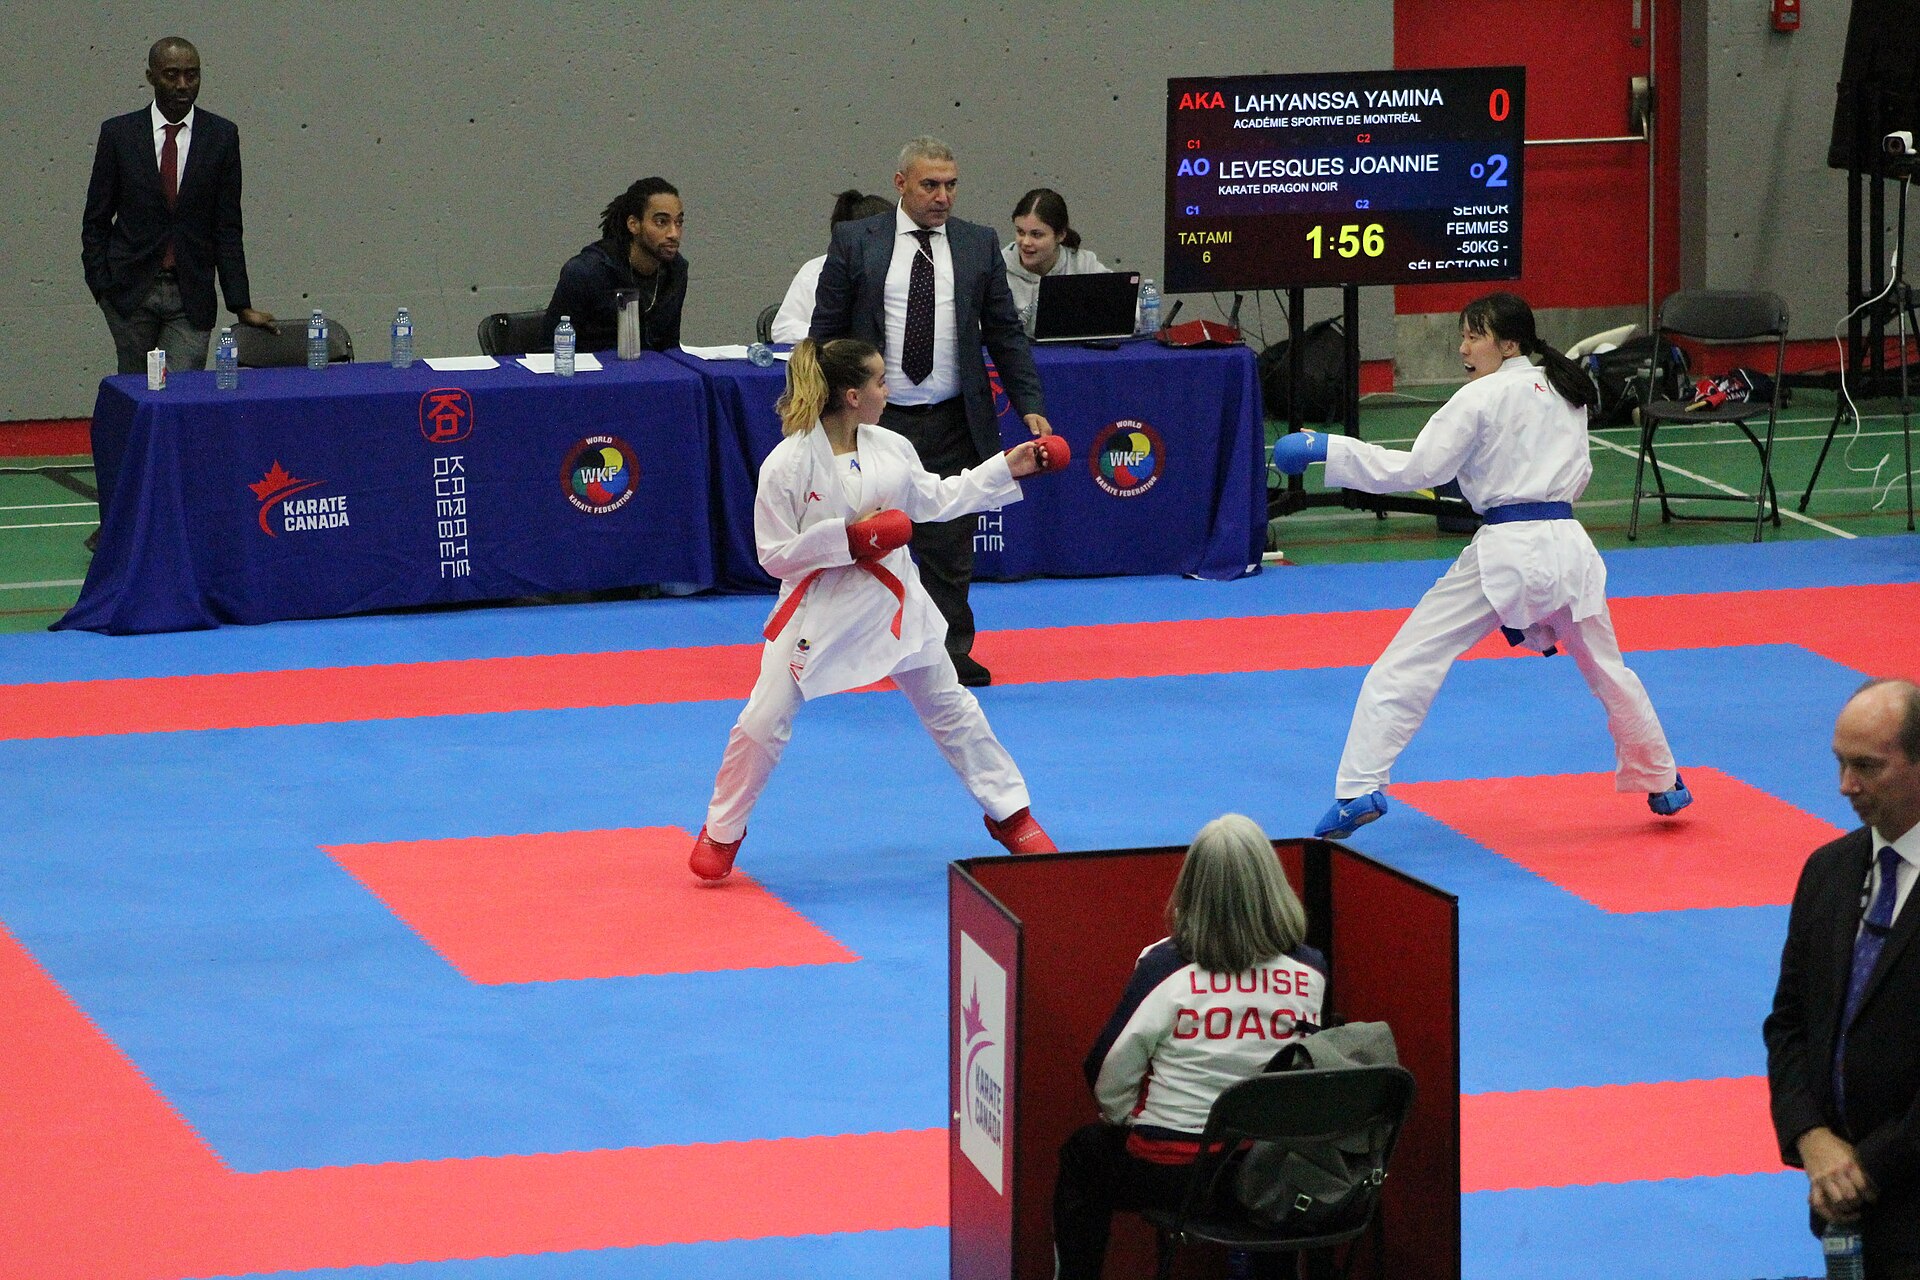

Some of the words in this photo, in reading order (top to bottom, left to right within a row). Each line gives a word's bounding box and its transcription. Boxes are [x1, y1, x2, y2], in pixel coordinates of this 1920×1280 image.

[1179, 91, 1225, 110] AKA
[1234, 91, 1359, 113] LAHYANSSA
[1363, 88, 1444, 108] YAMINA
[1489, 88, 1510, 121] 0
[1233, 116, 1289, 129] ACADÉMIE
[1291, 115, 1344, 127] SPORTIVE
[1346, 115, 1362, 125] DE
[1363, 111, 1422, 125] MONTRÉAL
[1187, 139, 1200, 149] C1
[1356, 133, 1371, 143] C2
[1177, 157, 1211, 177] AO
[1219, 157, 1345, 179] LEVESQUES
[1349, 154, 1439, 175] JOANNIE
[1218, 184, 1260, 195] KARATE
[1262, 183, 1309, 194] DRAGON
[1311, 181, 1339, 192] NOIR
[1185, 205, 1200, 215] C1
[1355, 199, 1370, 210] C2
[1453, 204, 1509, 216] SENIOR
[1446, 220, 1509, 235] FEMMES
[1178, 231, 1233, 245] TATAMI
[1306, 223, 1385, 259] 1:56
[1456, 239, 1499, 254] -50KG
[1202, 251, 1211, 264] 6
[1116, 420, 1142, 429] WORLD
[586, 435, 613, 445] WORLD
[1109, 451, 1145, 467] WKF
[580, 466, 618, 484] WKF
[1095, 475, 1118, 496] KARATE
[1119, 475, 1157, 497] FEDERATION
[283, 495, 348, 516] KARATE
[568, 494, 592, 513] KARATE
[593, 489, 633, 514] FEDERATION
[284, 511, 350, 532] CANADA
[1189, 968, 1309, 998] LOUISE
[975, 1061, 1002, 1116] KARATE
[975, 1096, 1002, 1150] CANADA
